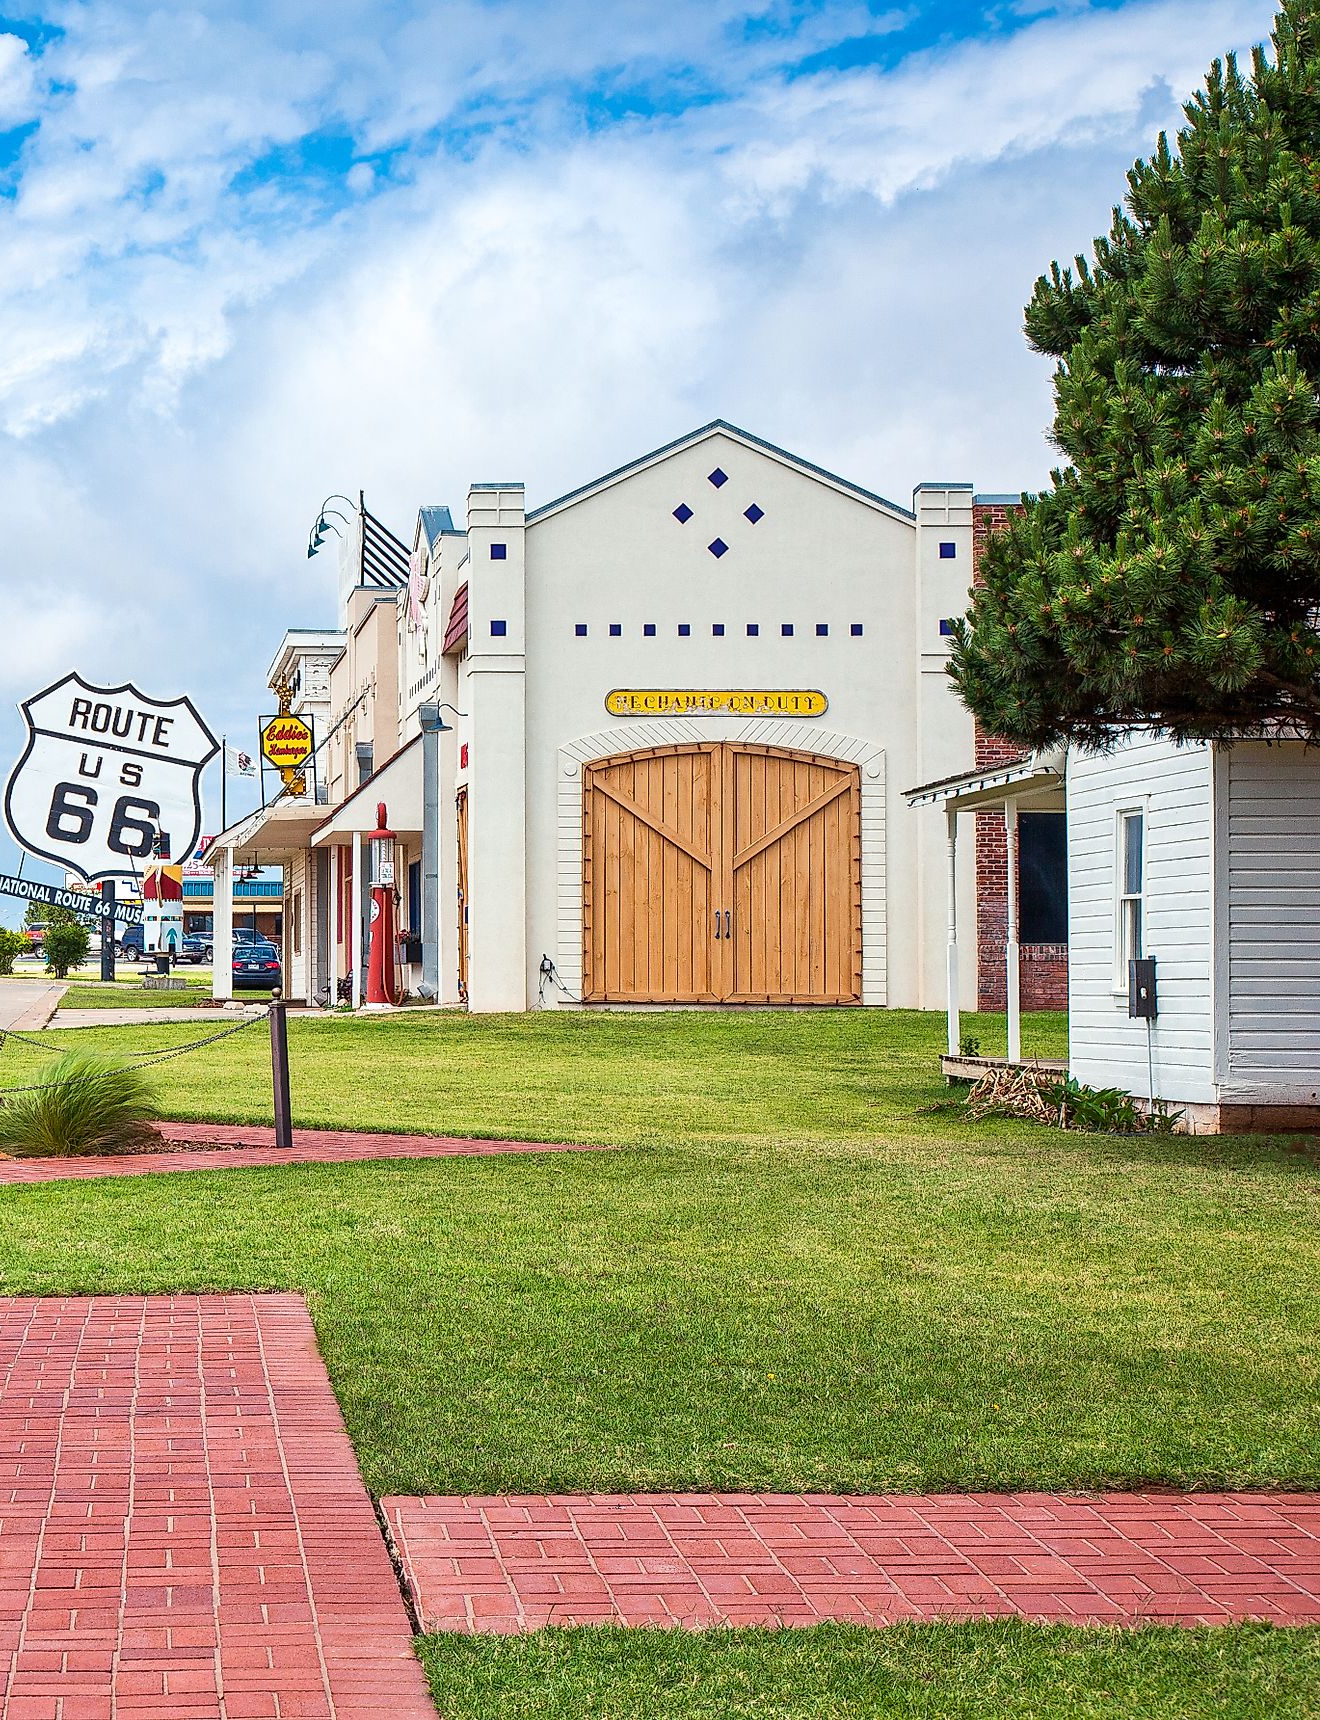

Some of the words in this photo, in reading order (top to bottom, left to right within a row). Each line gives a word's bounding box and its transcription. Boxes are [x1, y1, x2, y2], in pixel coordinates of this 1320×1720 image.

[729, 696, 755, 709] ON
[763, 696, 817, 710] DUTY
[68, 697, 175, 748] ROUTE
[266, 724, 309, 742] Eddie's
[268, 743, 308, 760] Hamburgers
[45, 781, 161, 858] 66
[54, 890, 92, 912] ROUTE
[94, 901, 111, 916] 66
